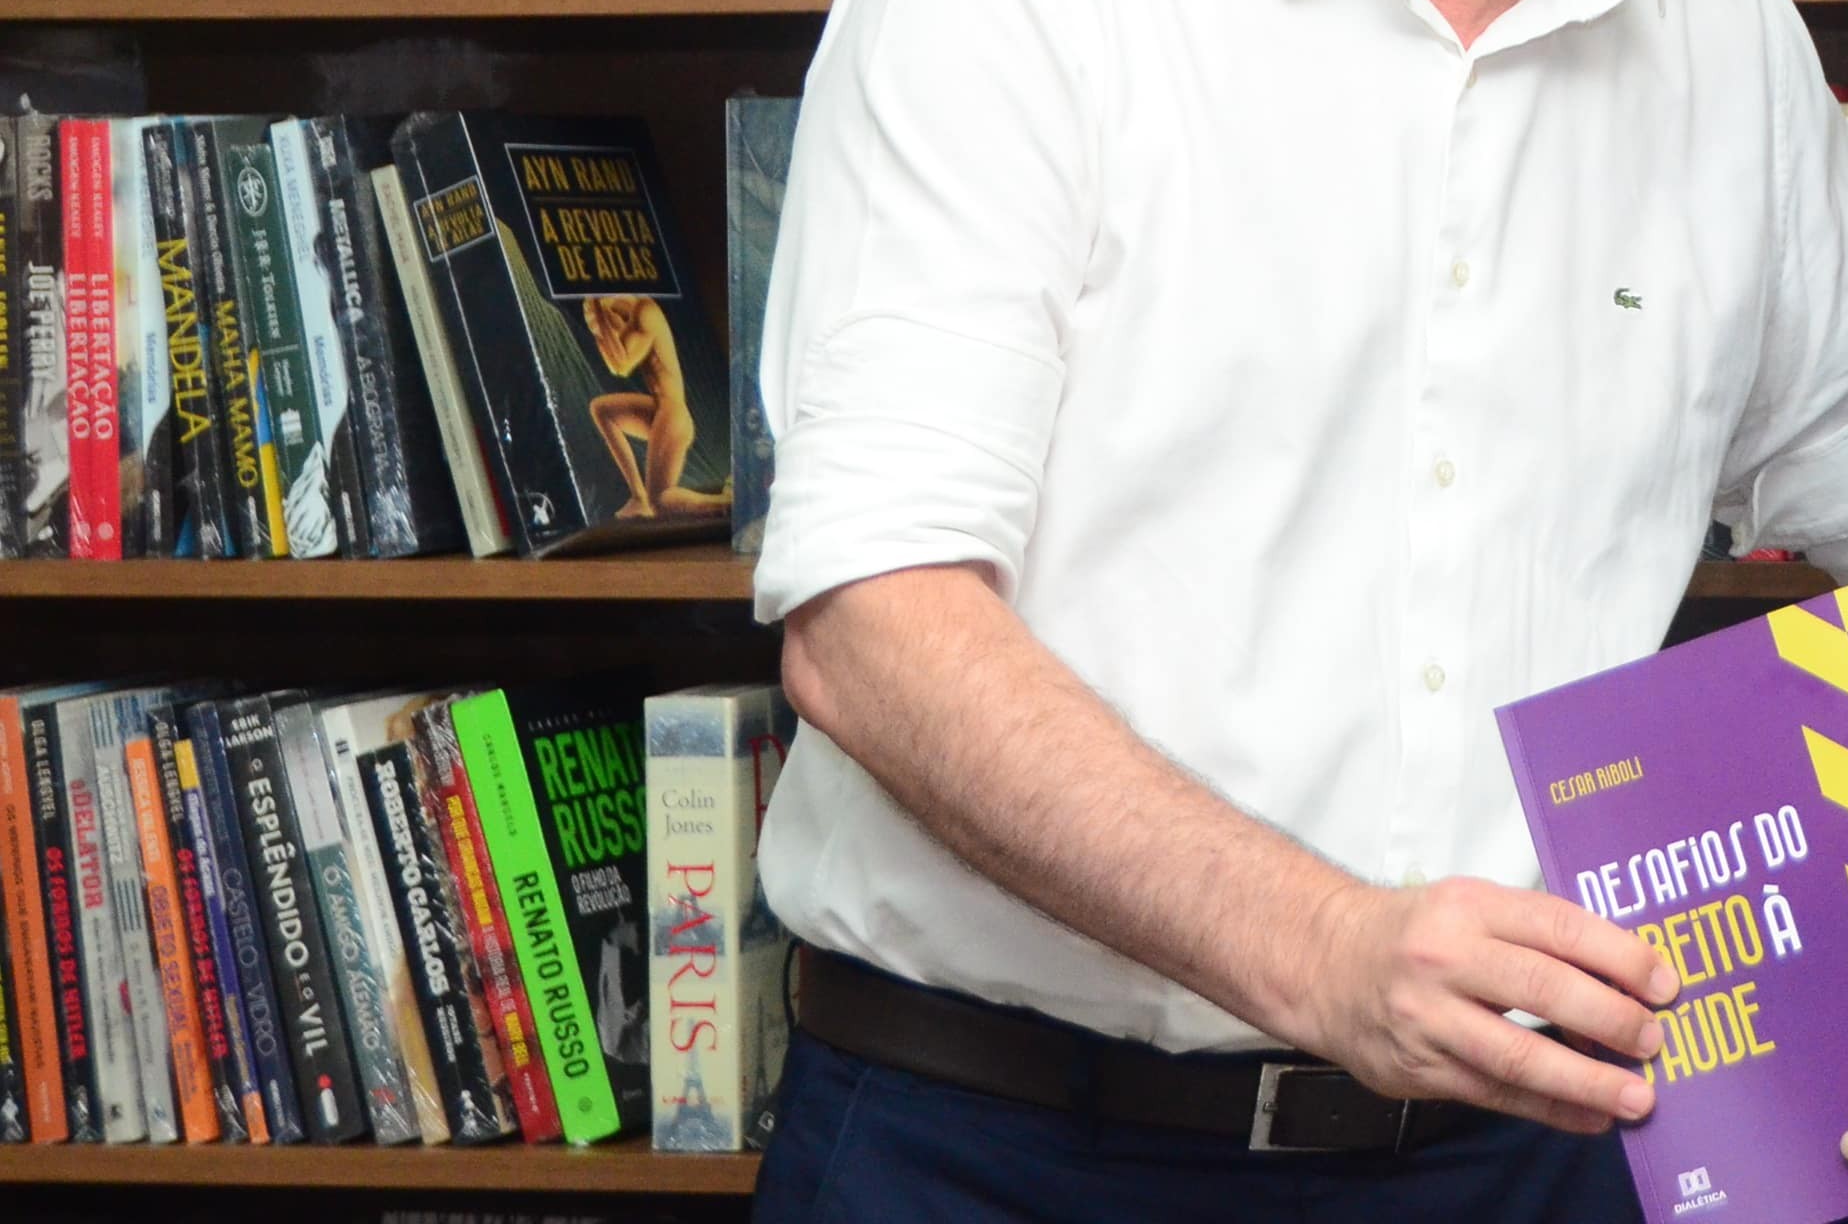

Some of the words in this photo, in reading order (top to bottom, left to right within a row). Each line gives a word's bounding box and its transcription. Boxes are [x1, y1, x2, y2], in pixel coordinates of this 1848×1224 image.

[522, 154, 564, 189] AYN
[569, 157, 638, 194] RAND
[329, 199, 363, 324] METALLICA
[542, 212, 558, 245] A
[564, 208, 656, 248] REVOLTA
[558, 246, 591, 277] DE
[596, 245, 659, 282] ATLAS
[88, 272, 114, 439] LIBERTAÇÃO
[156, 238, 211, 444] MANDELA
[214, 299, 249, 391] MAHA
[225, 396, 260, 488] MAMO
[661, 788, 716, 810] Colin
[662, 814, 715, 838] Jones
[1549, 766, 1598, 805] CESAR
[1595, 755, 1644, 792] RIBOLI
[375, 759, 423, 887] ROBERTO
[409, 886, 450, 997] CARLOS
[1576, 820, 1750, 921] DESAFIOS
[1753, 804, 1810, 865] DO
[247, 777, 310, 967] ESPLÊNDIDO
[298, 1003, 329, 1058] VIL
[666, 860, 720, 1056] PARIS
[1644, 894, 1764, 986] REITO
[1762, 883, 1804, 959] À
[512, 871, 563, 981] RENATO
[542, 986, 591, 1079] RUSSO
[1673, 1189, 1728, 1215] DIALÉTICA
